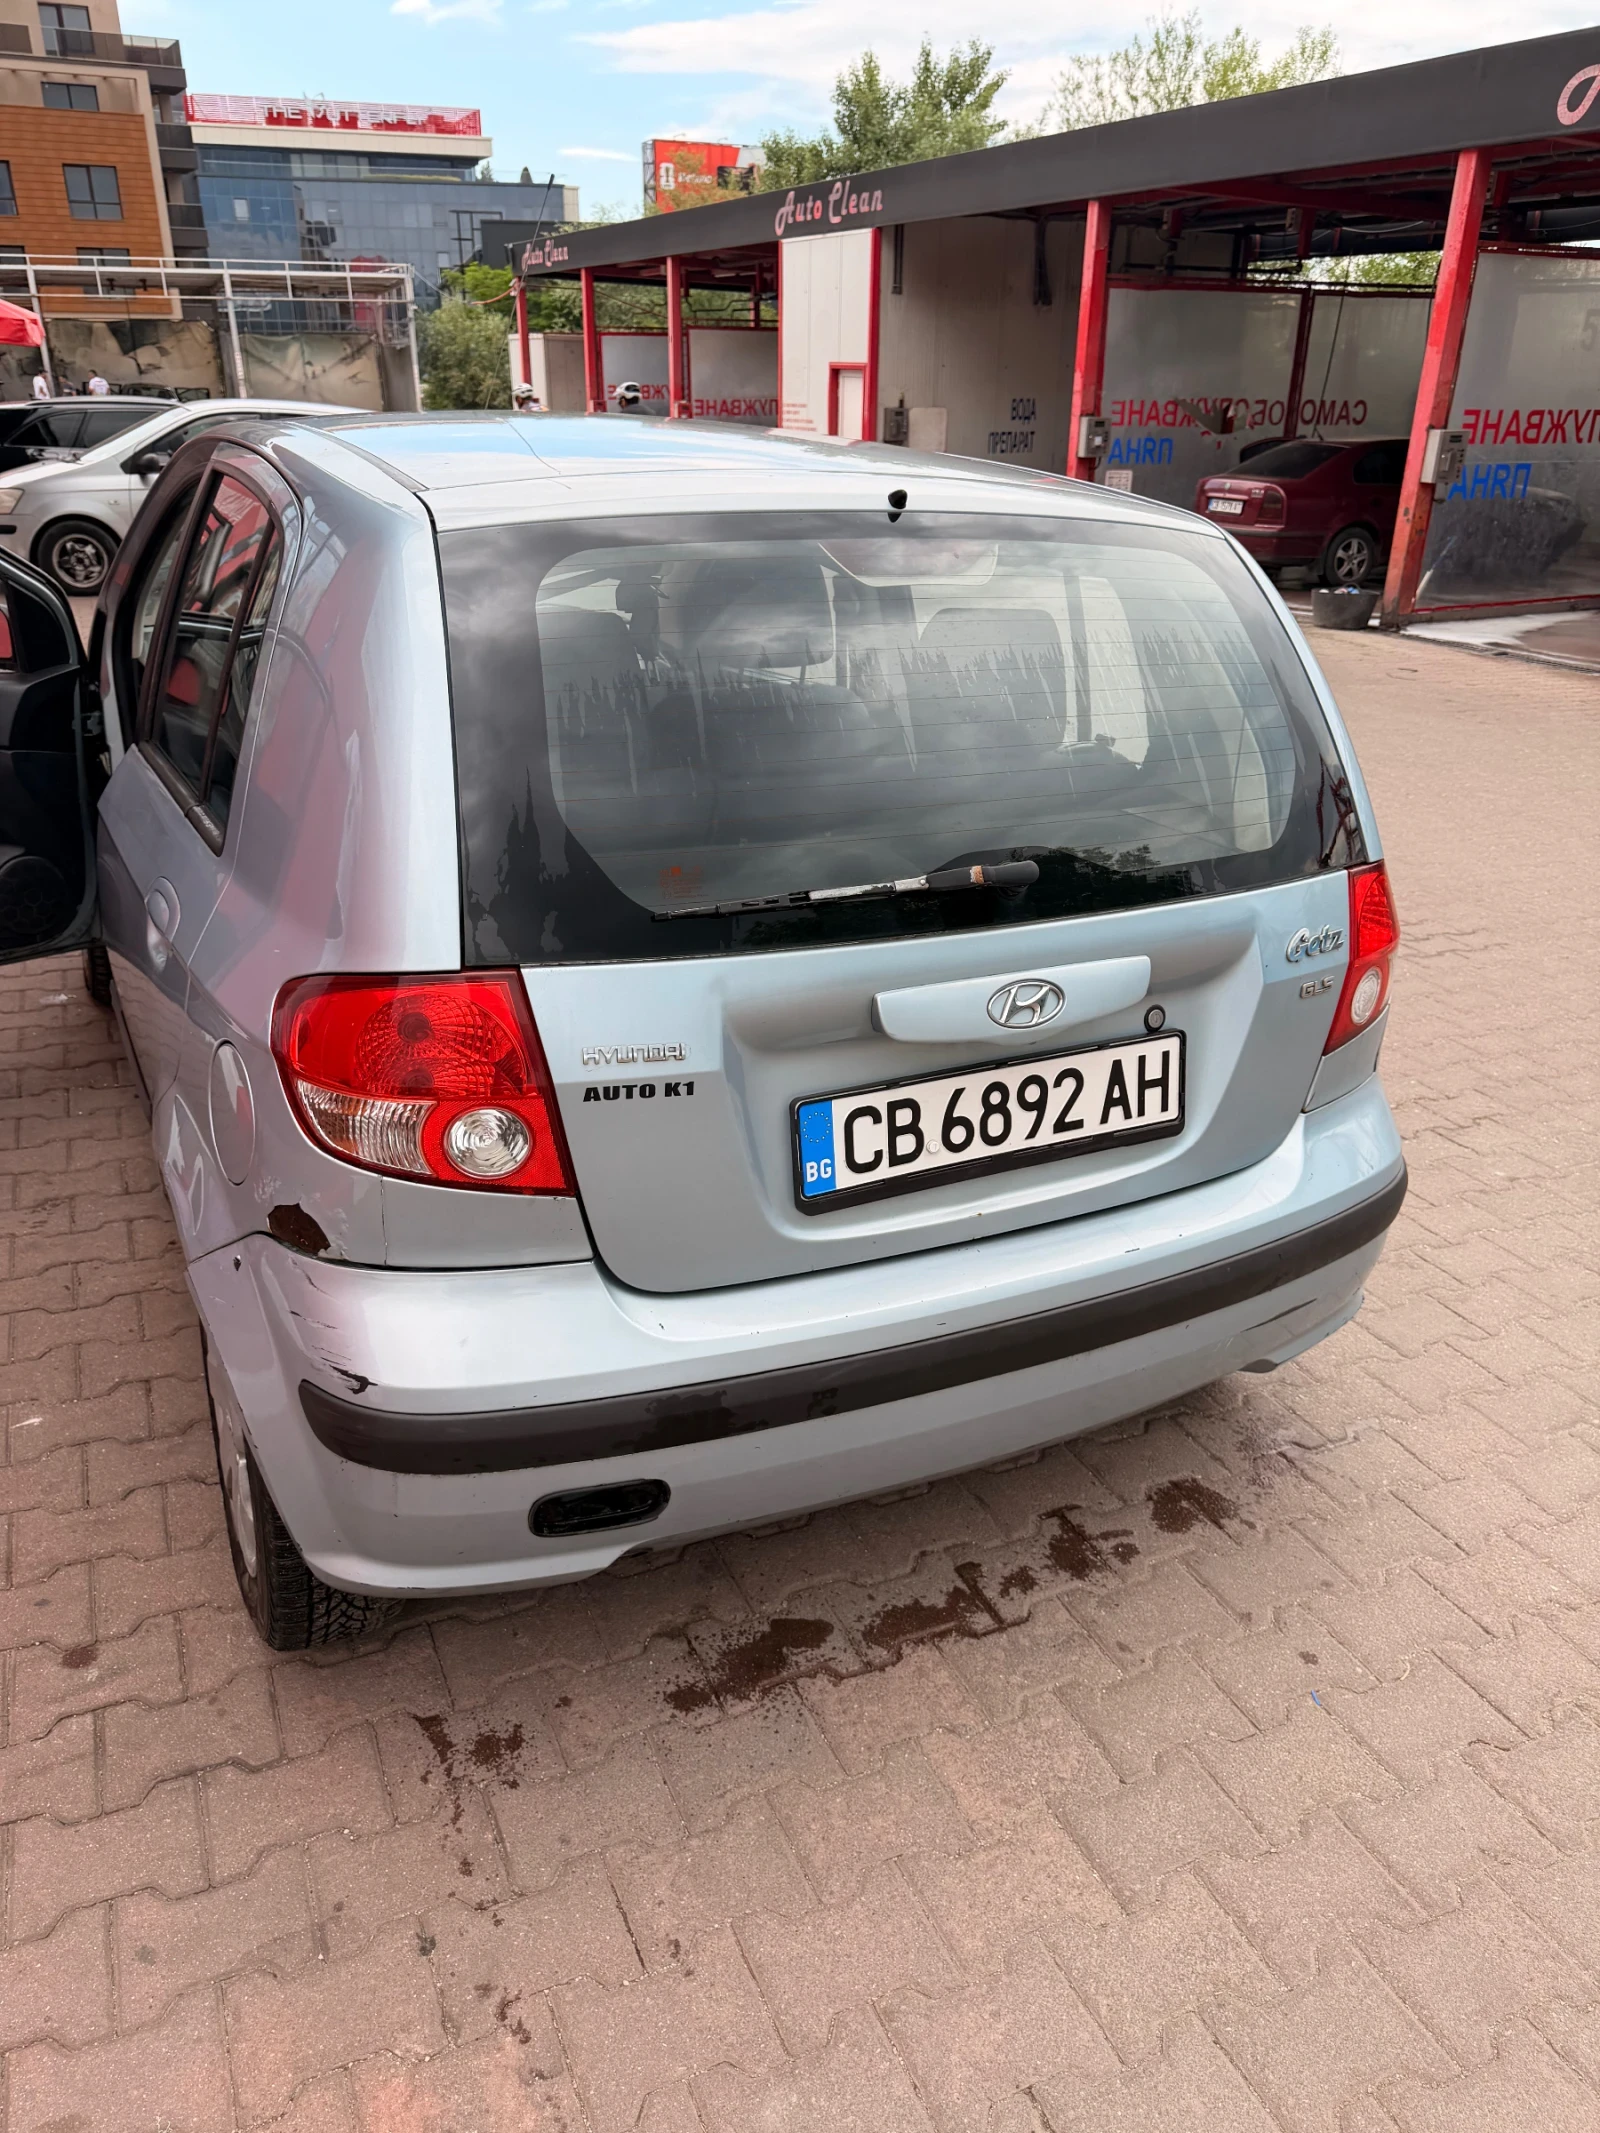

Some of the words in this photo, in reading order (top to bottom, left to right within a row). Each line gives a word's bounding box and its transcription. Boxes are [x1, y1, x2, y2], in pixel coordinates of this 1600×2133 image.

[262, 105, 303, 119] THE
[774, 190, 823, 237] Auto
[828, 180, 884, 225] Clean
[1286, 924, 1346, 963] Getz
[1300, 975, 1335, 999] GLS
[582, 1042, 686, 1066] HYUNDAI
[582, 1083, 656, 1103] AUTO
[664, 1081, 695, 1098] K1
[843, 1097, 925, 1174] CB
[940, 1067, 1085, 1154] 6892
[1099, 1049, 1171, 1125] AH
[805, 1158, 832, 1184] BG
